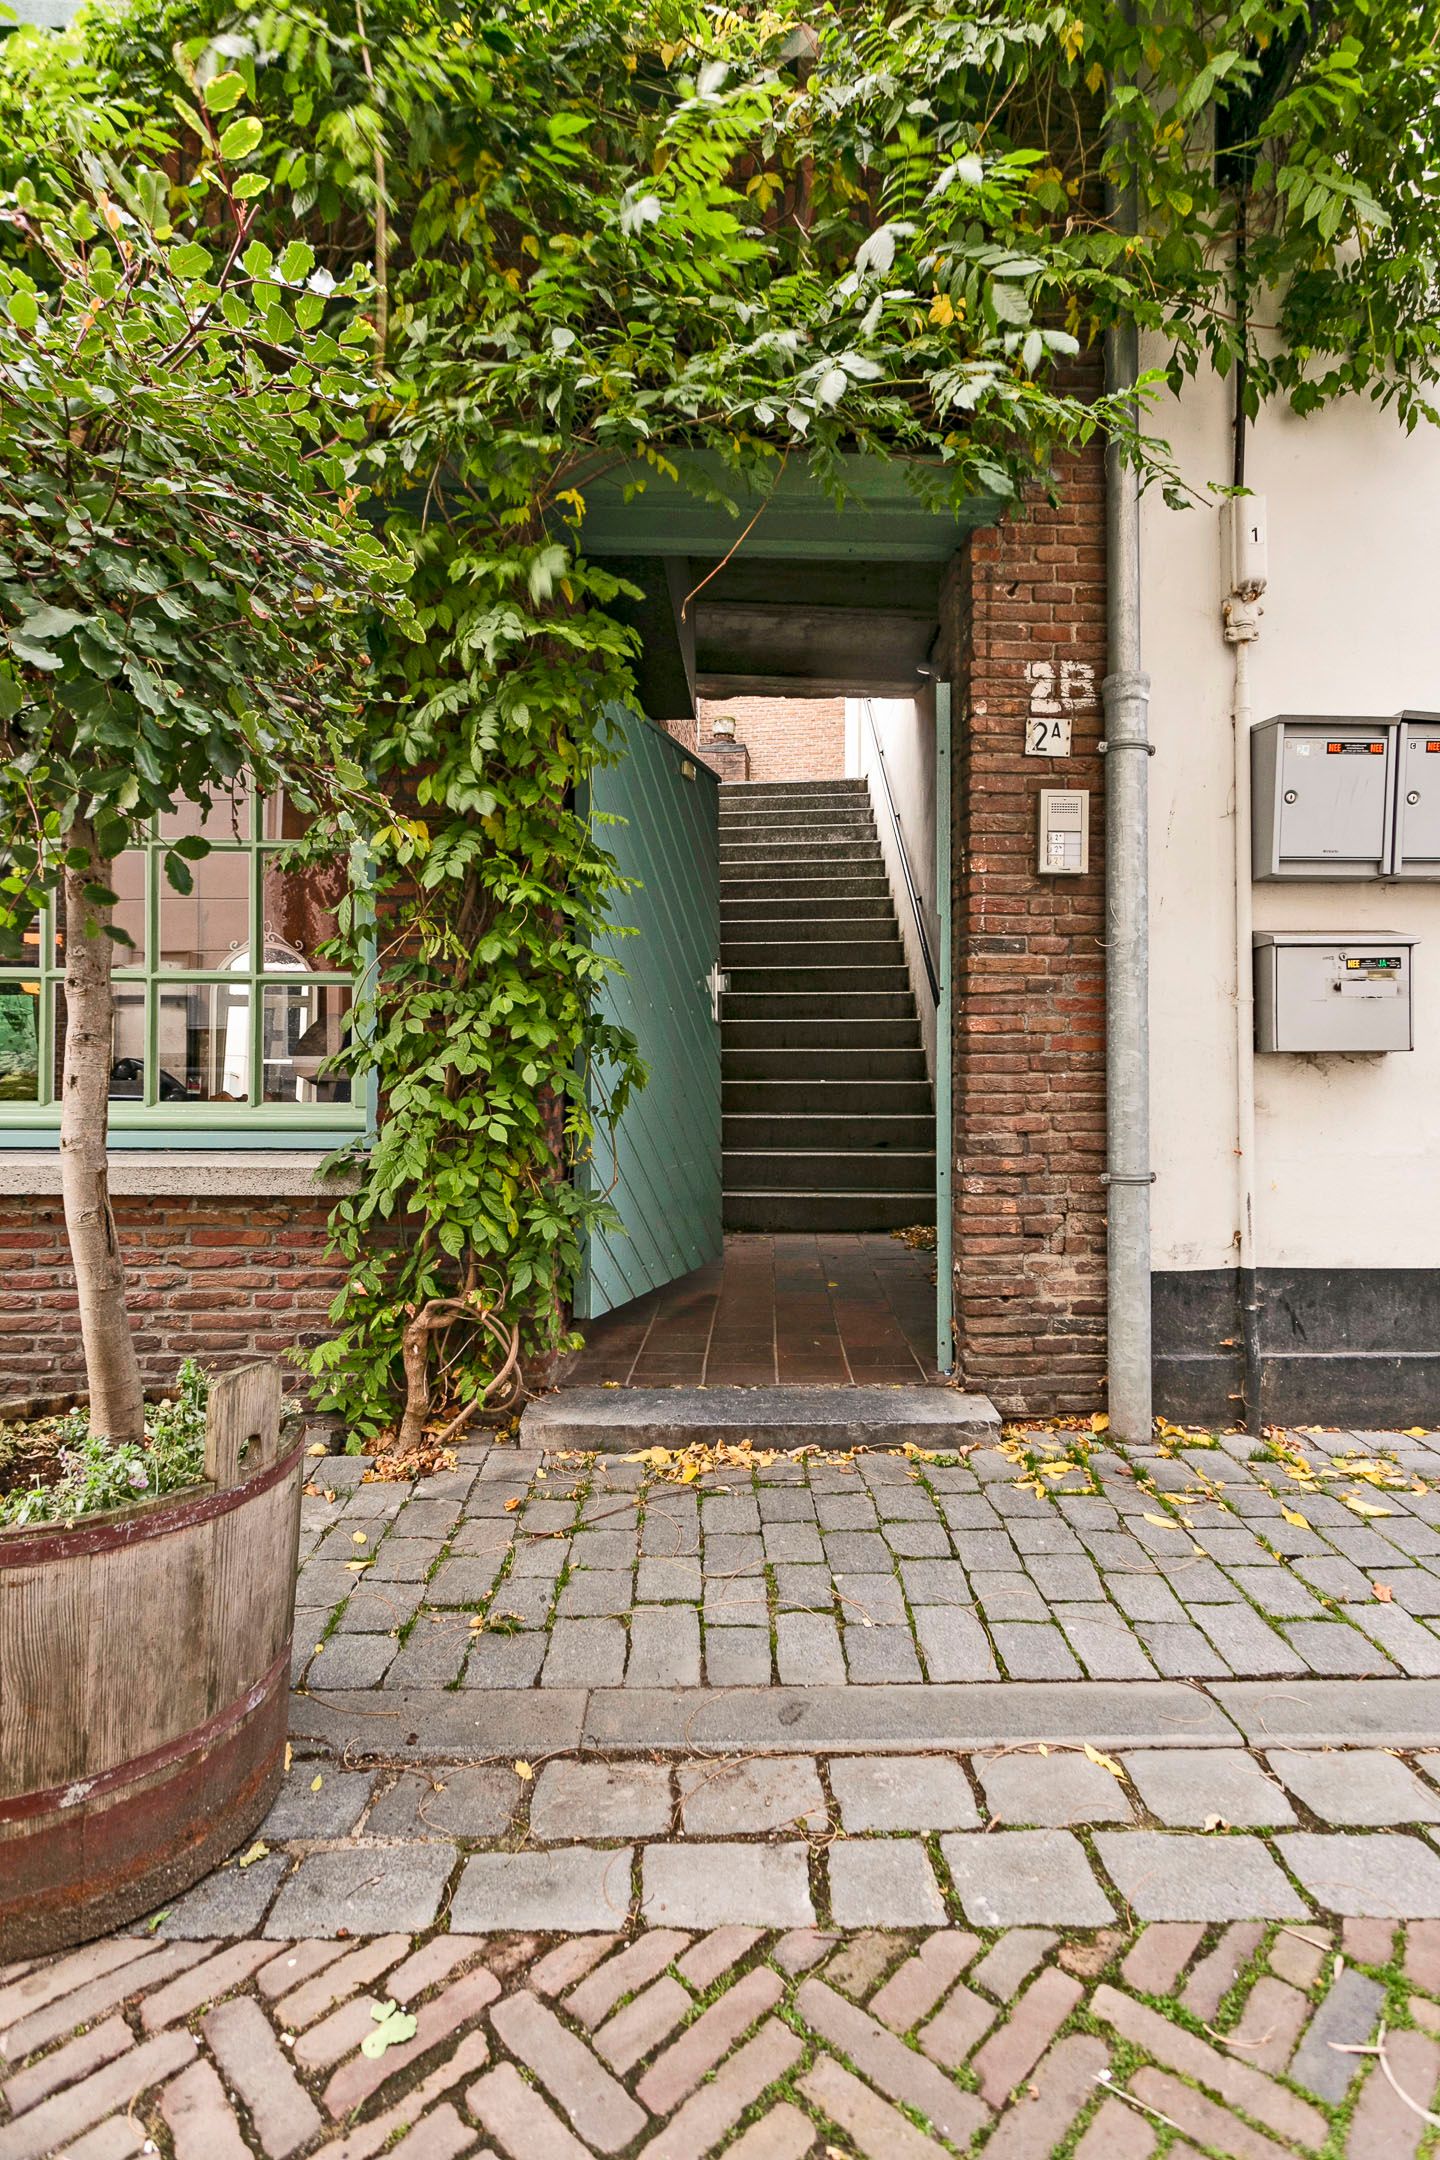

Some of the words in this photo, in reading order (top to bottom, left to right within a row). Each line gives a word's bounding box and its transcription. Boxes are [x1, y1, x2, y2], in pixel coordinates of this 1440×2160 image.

[1252, 527, 1258, 542] 1
[1032, 721, 1061, 751] 2A
[1328, 743, 1341, 752] NEE
[1370, 744, 1383, 753] NEE
[1347, 959, 1360, 968] NEE
[1378, 959, 1387, 967] JA
